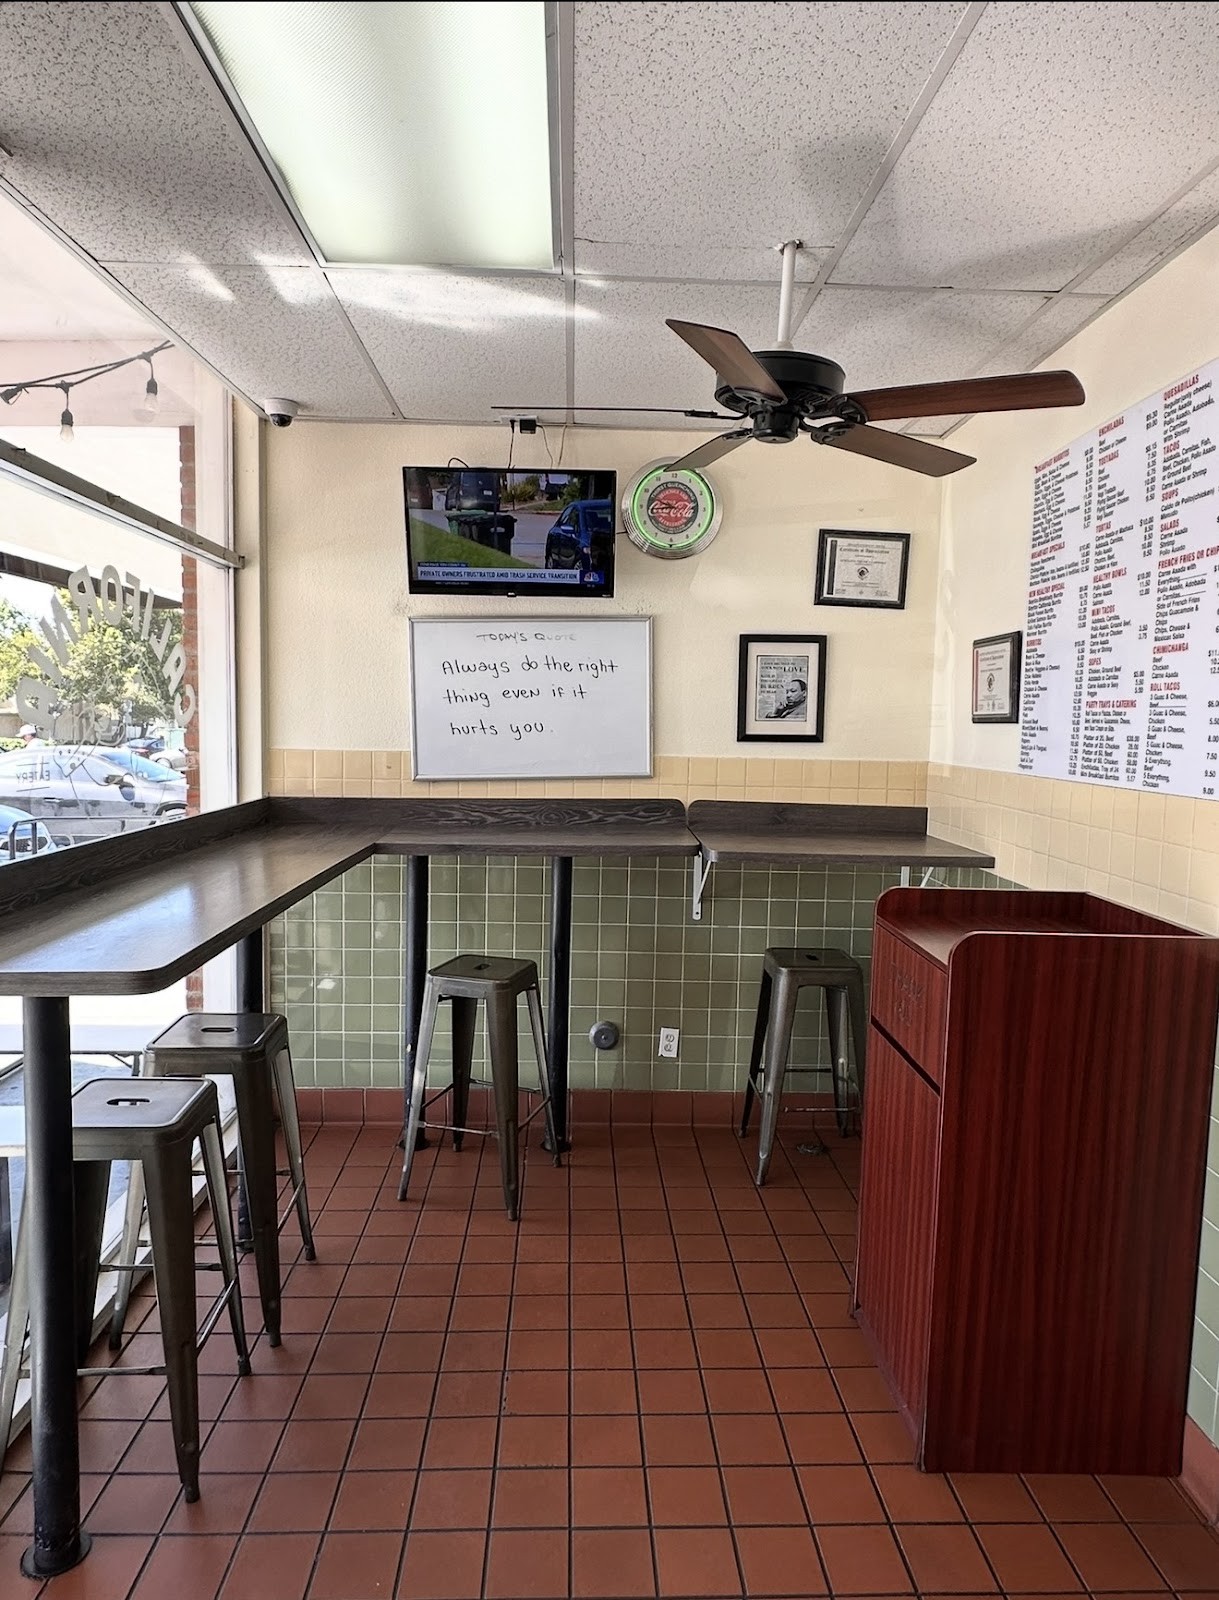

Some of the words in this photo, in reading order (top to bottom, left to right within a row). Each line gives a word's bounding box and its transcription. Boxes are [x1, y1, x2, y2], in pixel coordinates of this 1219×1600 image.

[1164, 374, 1199, 401] QUESADILLAS
[1164, 440, 1179, 455] TACOS
[1162, 488, 1178, 501] SOUPS
[1161, 519, 1179, 532] SALADS
[1158, 556, 1178, 569] FRENCH
[1180, 552, 1195, 564] FRIES
[1197, 550, 1204, 559] OR
[442, 659, 510, 679] Always
[522, 655, 539, 671] do
[544, 655, 573, 673] the
[579, 656, 619, 679] right
[1150, 683, 1162, 691] ROLL
[1164, 682, 1180, 690] TACOS
[442, 688, 491, 707] thing
[502, 688, 540, 699] even
[552, 684, 564, 697] if
[573, 684, 588, 699] it
[450, 719, 498, 736] hurts
